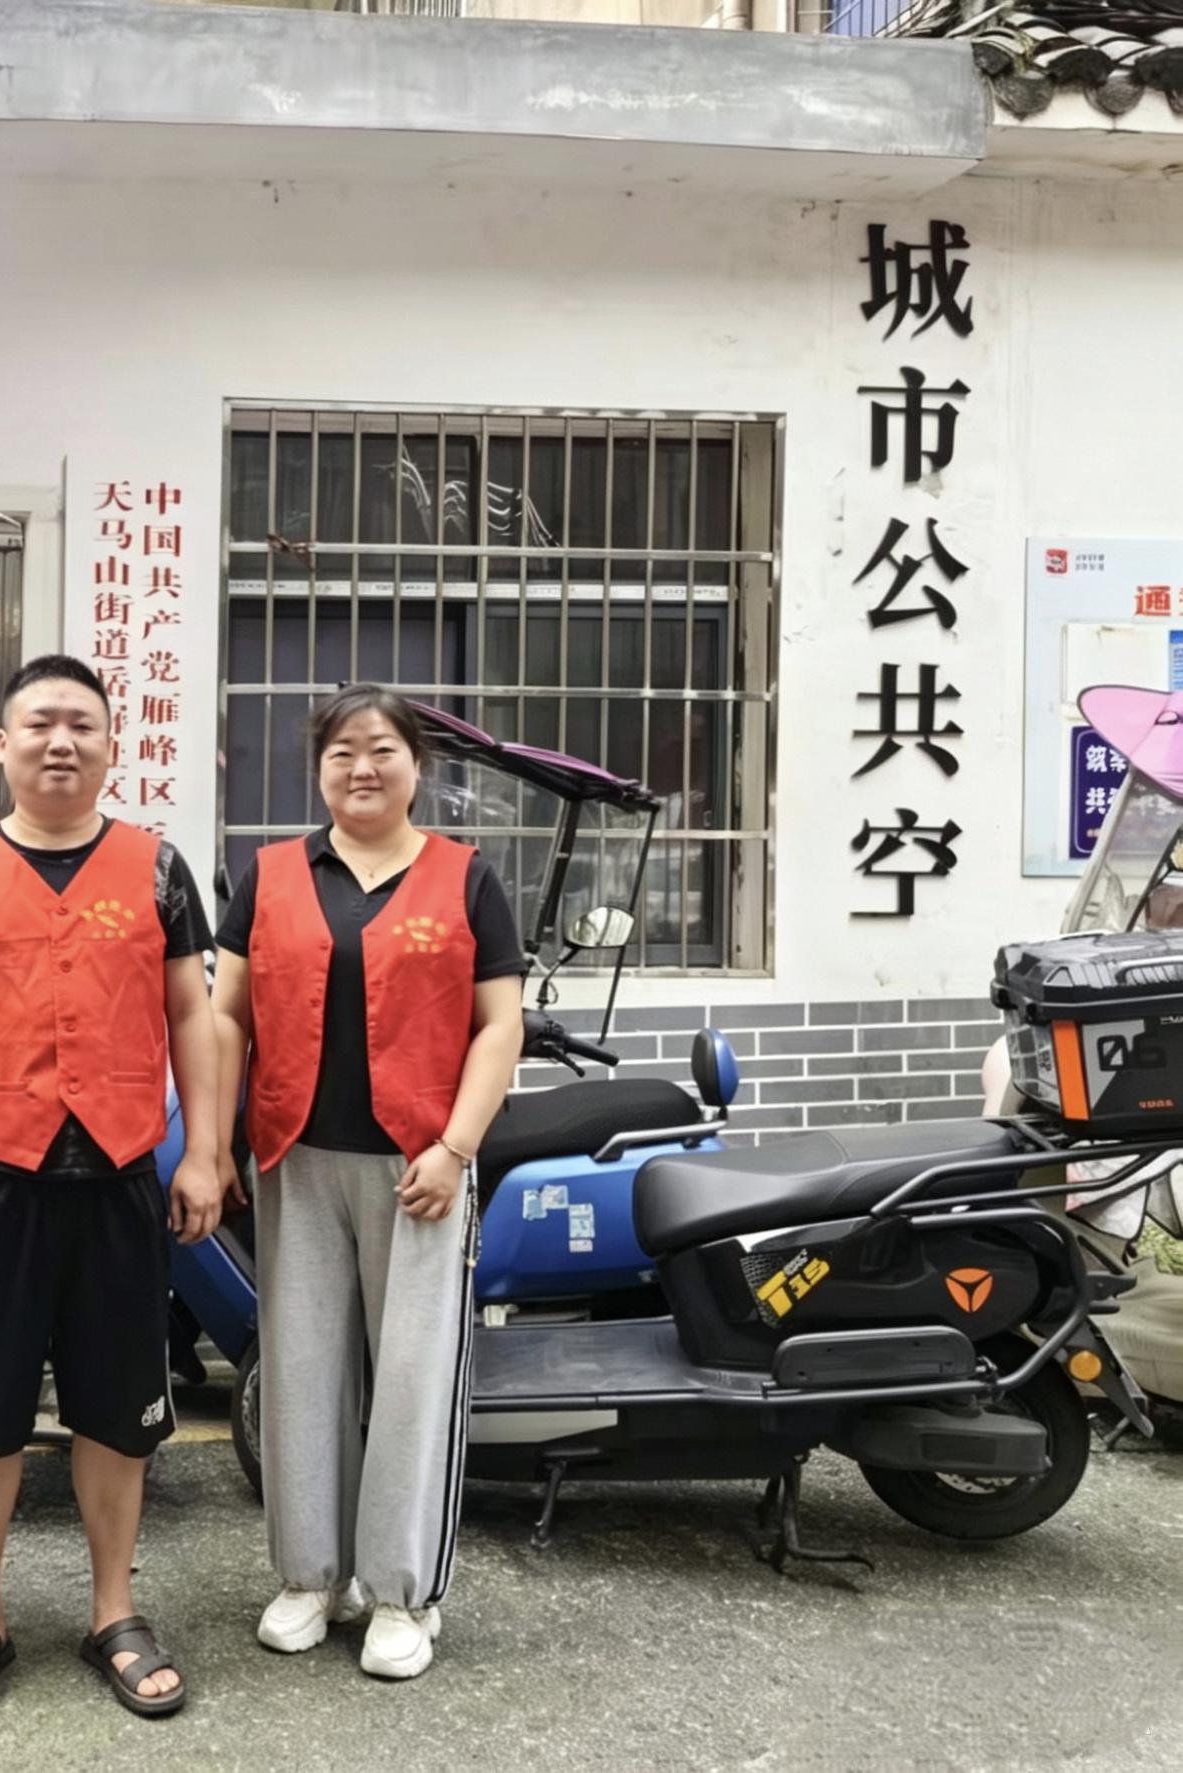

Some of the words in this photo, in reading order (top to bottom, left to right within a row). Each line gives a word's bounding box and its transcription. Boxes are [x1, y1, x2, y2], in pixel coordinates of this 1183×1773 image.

[140, 482, 182, 836] 中国共产党雁峰区
[850, 220, 973, 922] 城市公共空
[1134, 585, 1183, 617] 通
